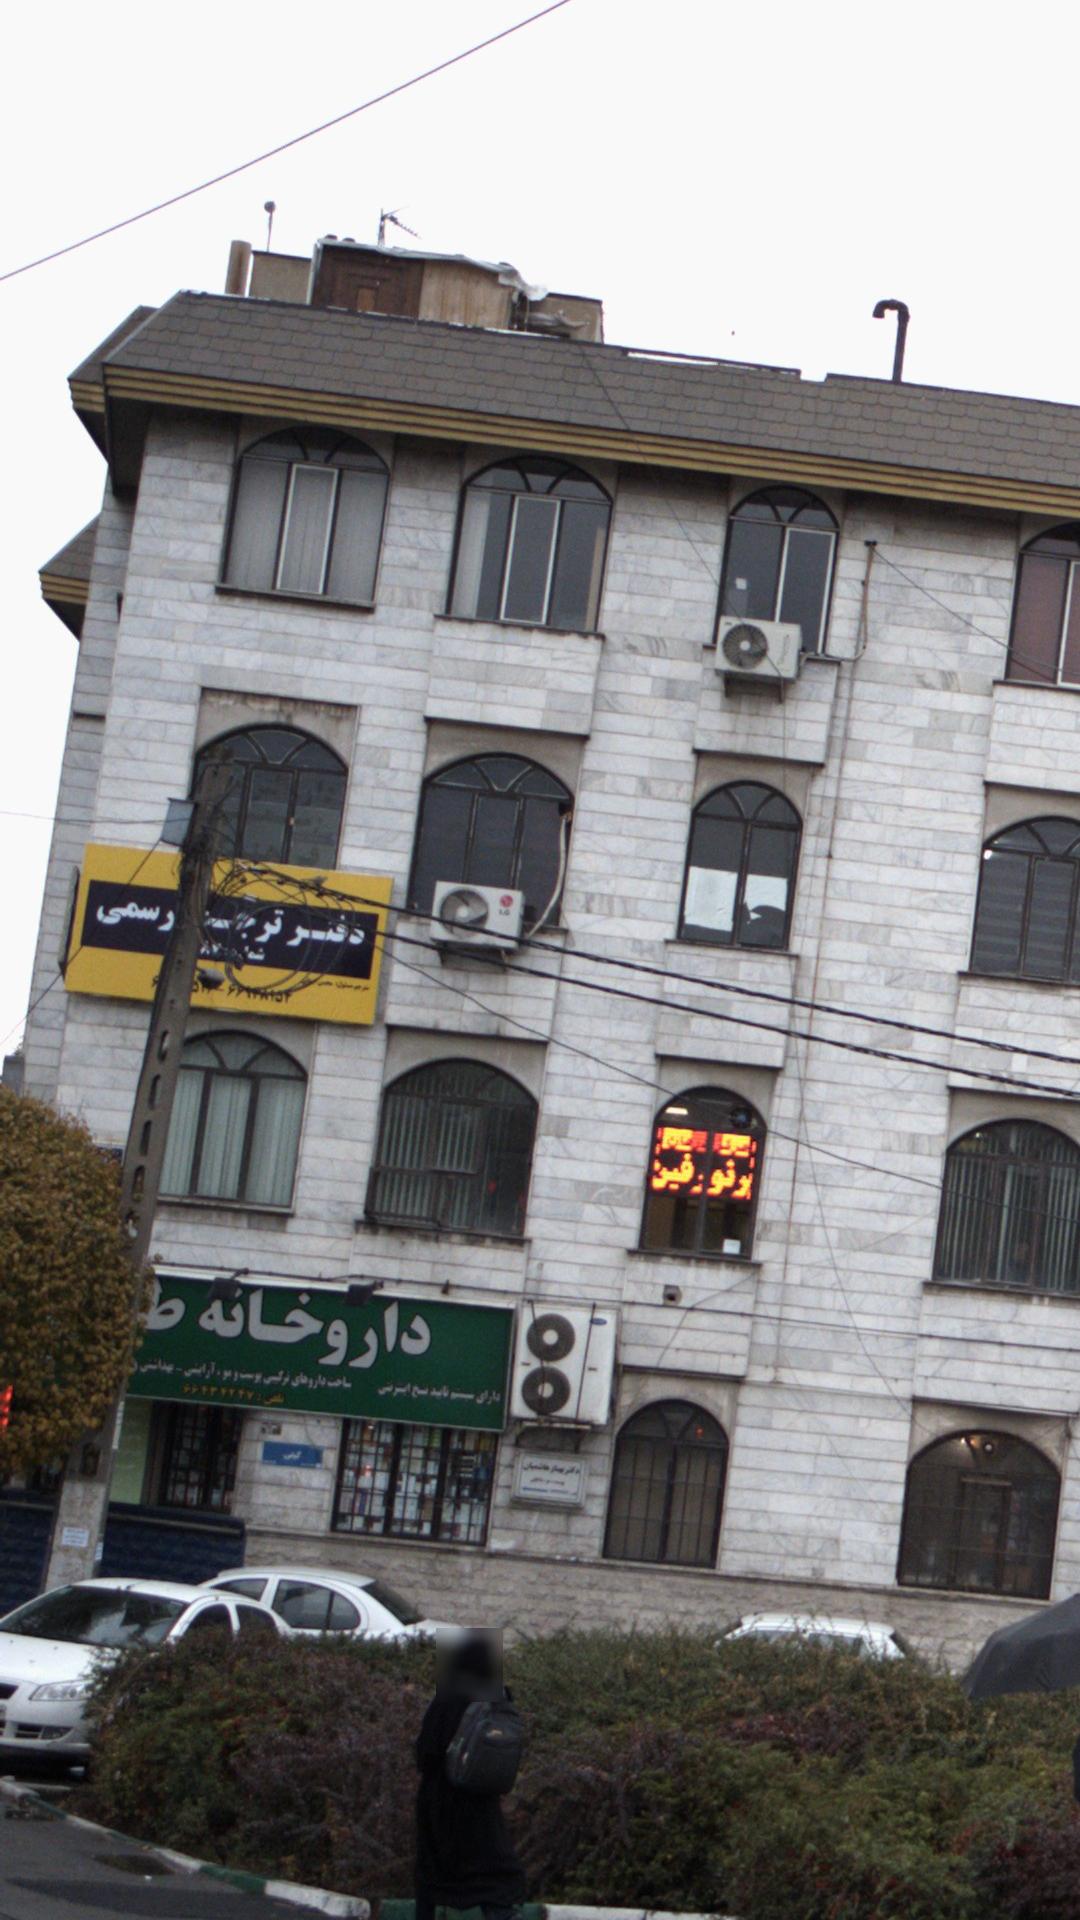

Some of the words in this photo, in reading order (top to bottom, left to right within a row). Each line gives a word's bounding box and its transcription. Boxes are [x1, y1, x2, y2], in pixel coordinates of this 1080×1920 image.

[96, 902, 175, 932] رسمی
[286, 914, 365, 947] دفتر
[198, 1287, 432, 1369] داروخانه
[291, 1371, 327, 1390] داروهای
